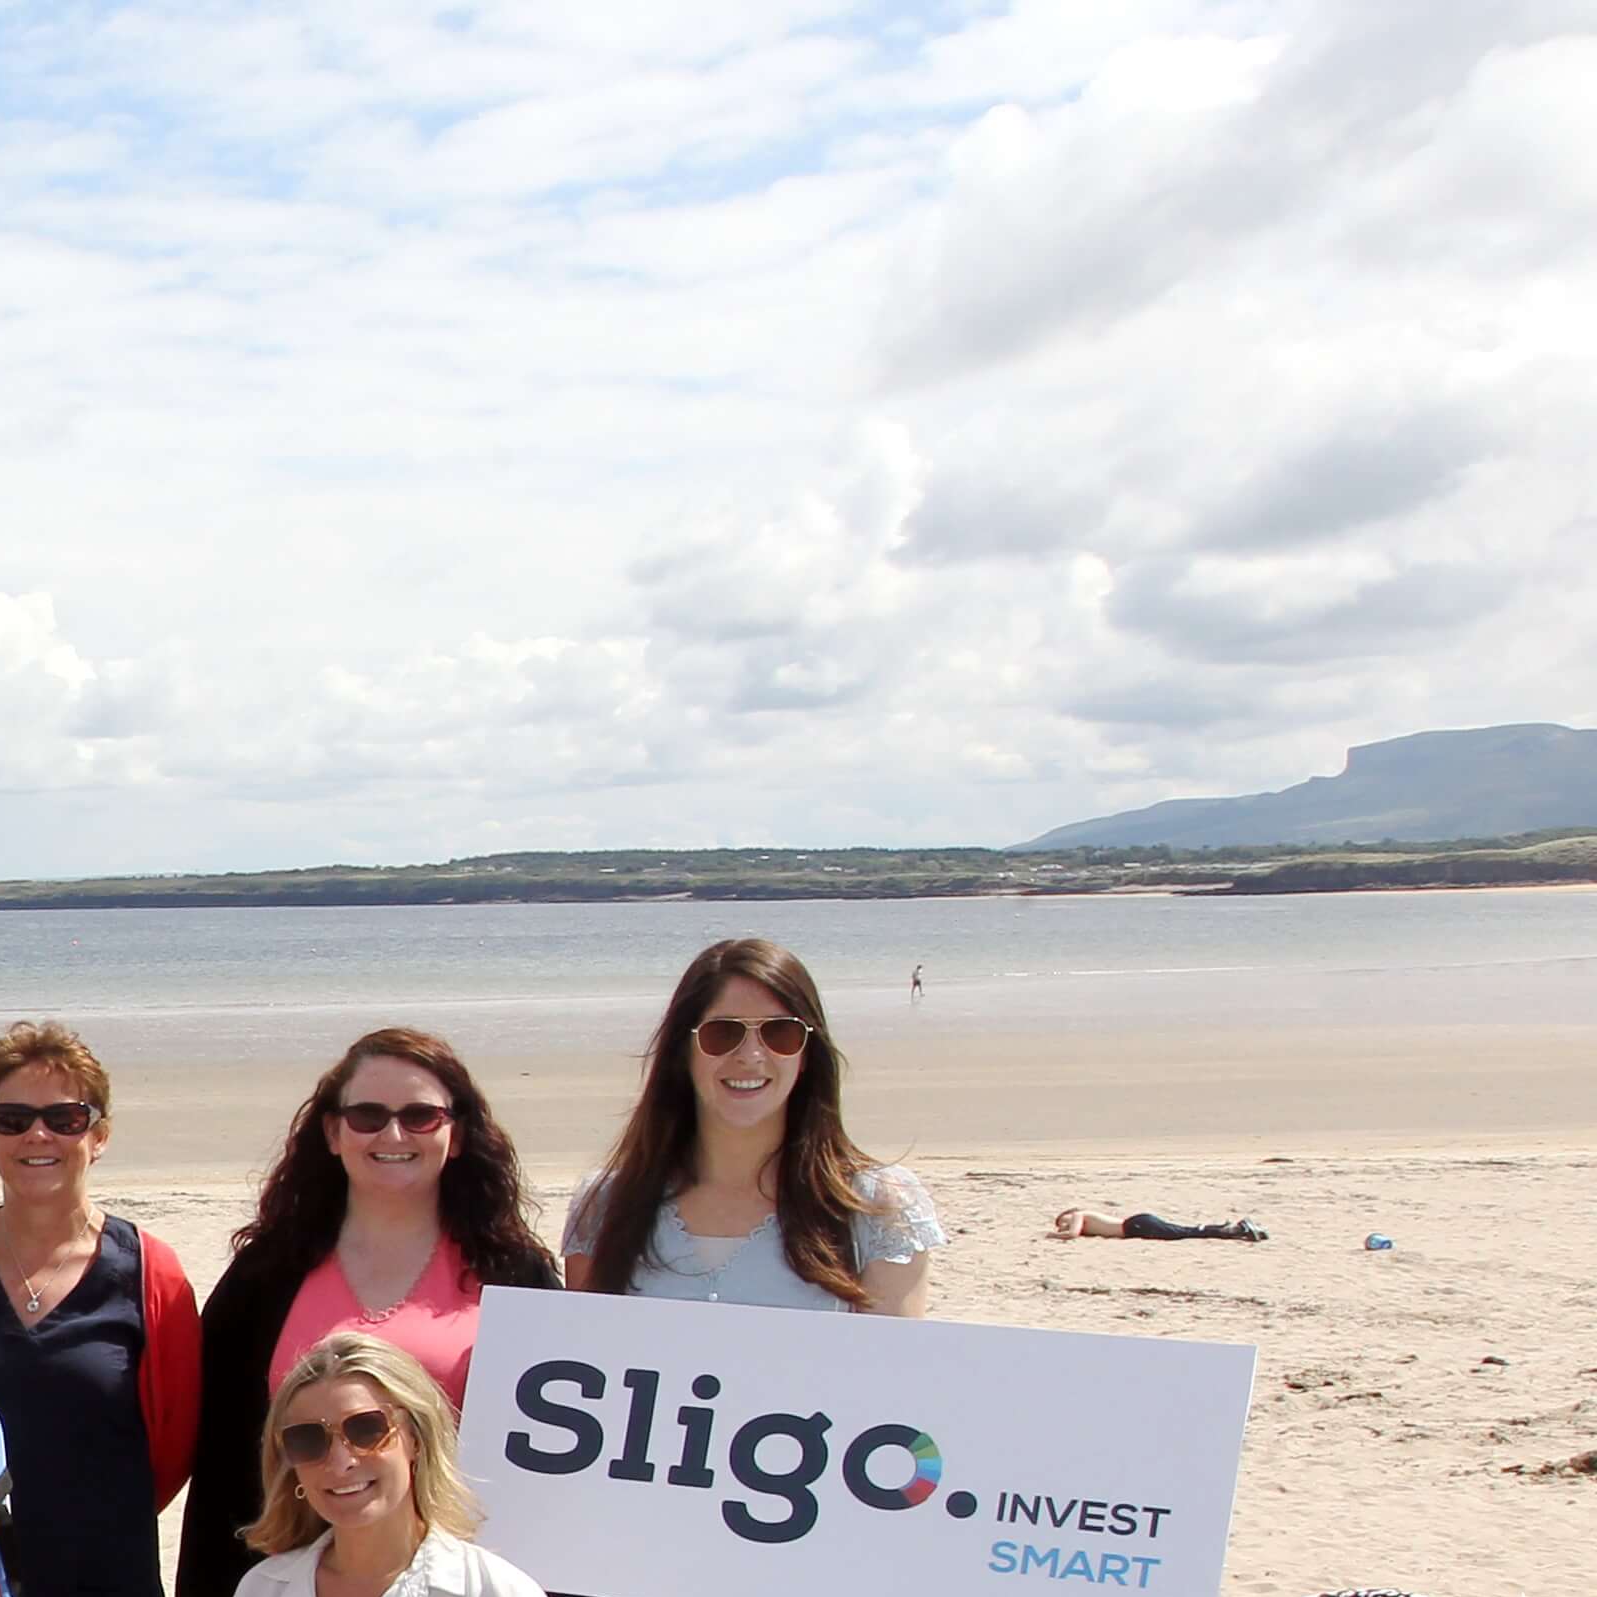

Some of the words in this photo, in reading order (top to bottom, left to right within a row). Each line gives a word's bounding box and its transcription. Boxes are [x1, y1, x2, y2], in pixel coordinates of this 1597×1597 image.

[504, 1360, 978, 1544] Sligo.
[996, 1491, 1172, 1539] INVEST
[987, 1541, 1162, 1589] SMART
